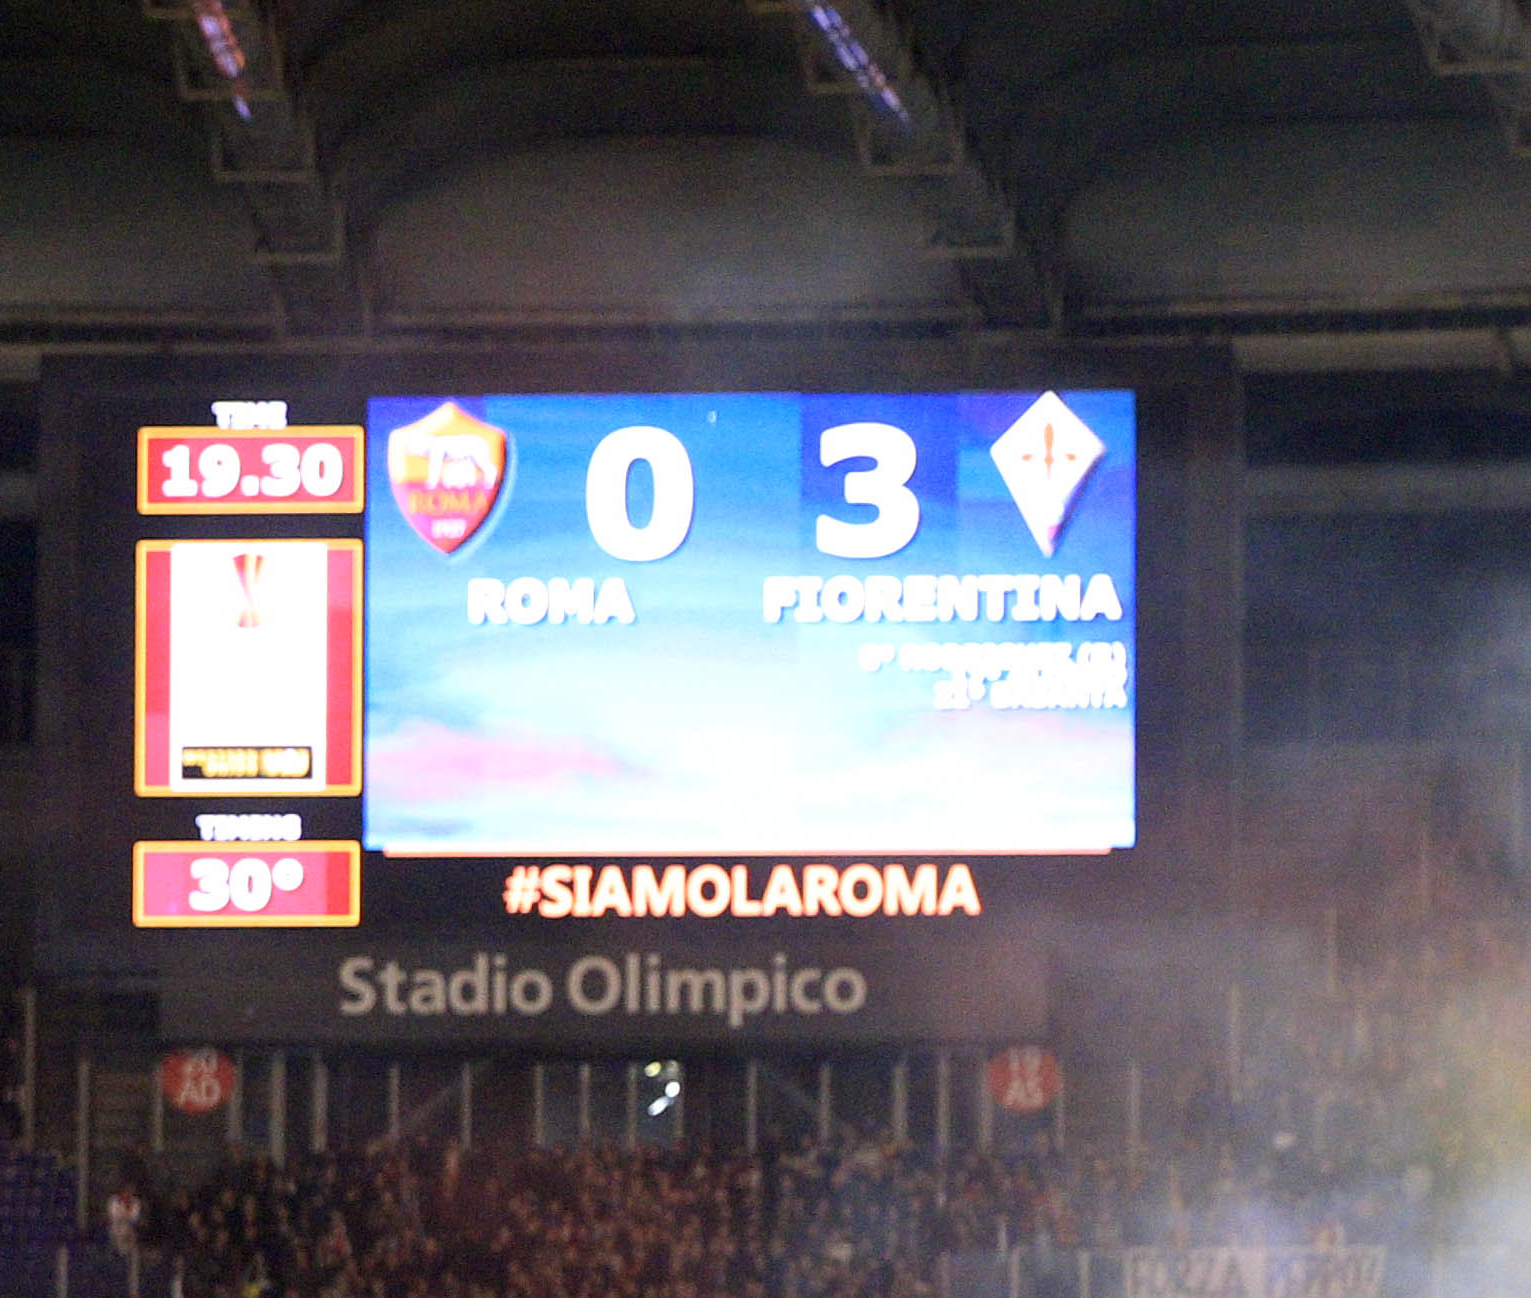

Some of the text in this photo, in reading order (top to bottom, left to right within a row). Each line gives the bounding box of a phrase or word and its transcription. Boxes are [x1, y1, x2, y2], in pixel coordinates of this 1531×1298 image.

[161, 442, 344, 498] 19.30
[586, 422, 920, 561] 0 3
[468, 577, 636, 624] ROMA
[763, 574, 1123, 623] FIORENTINA
[502, 864, 981, 918] #SIAMOLAROMA
[338, 953, 867, 1029] Stadio Olimpico
